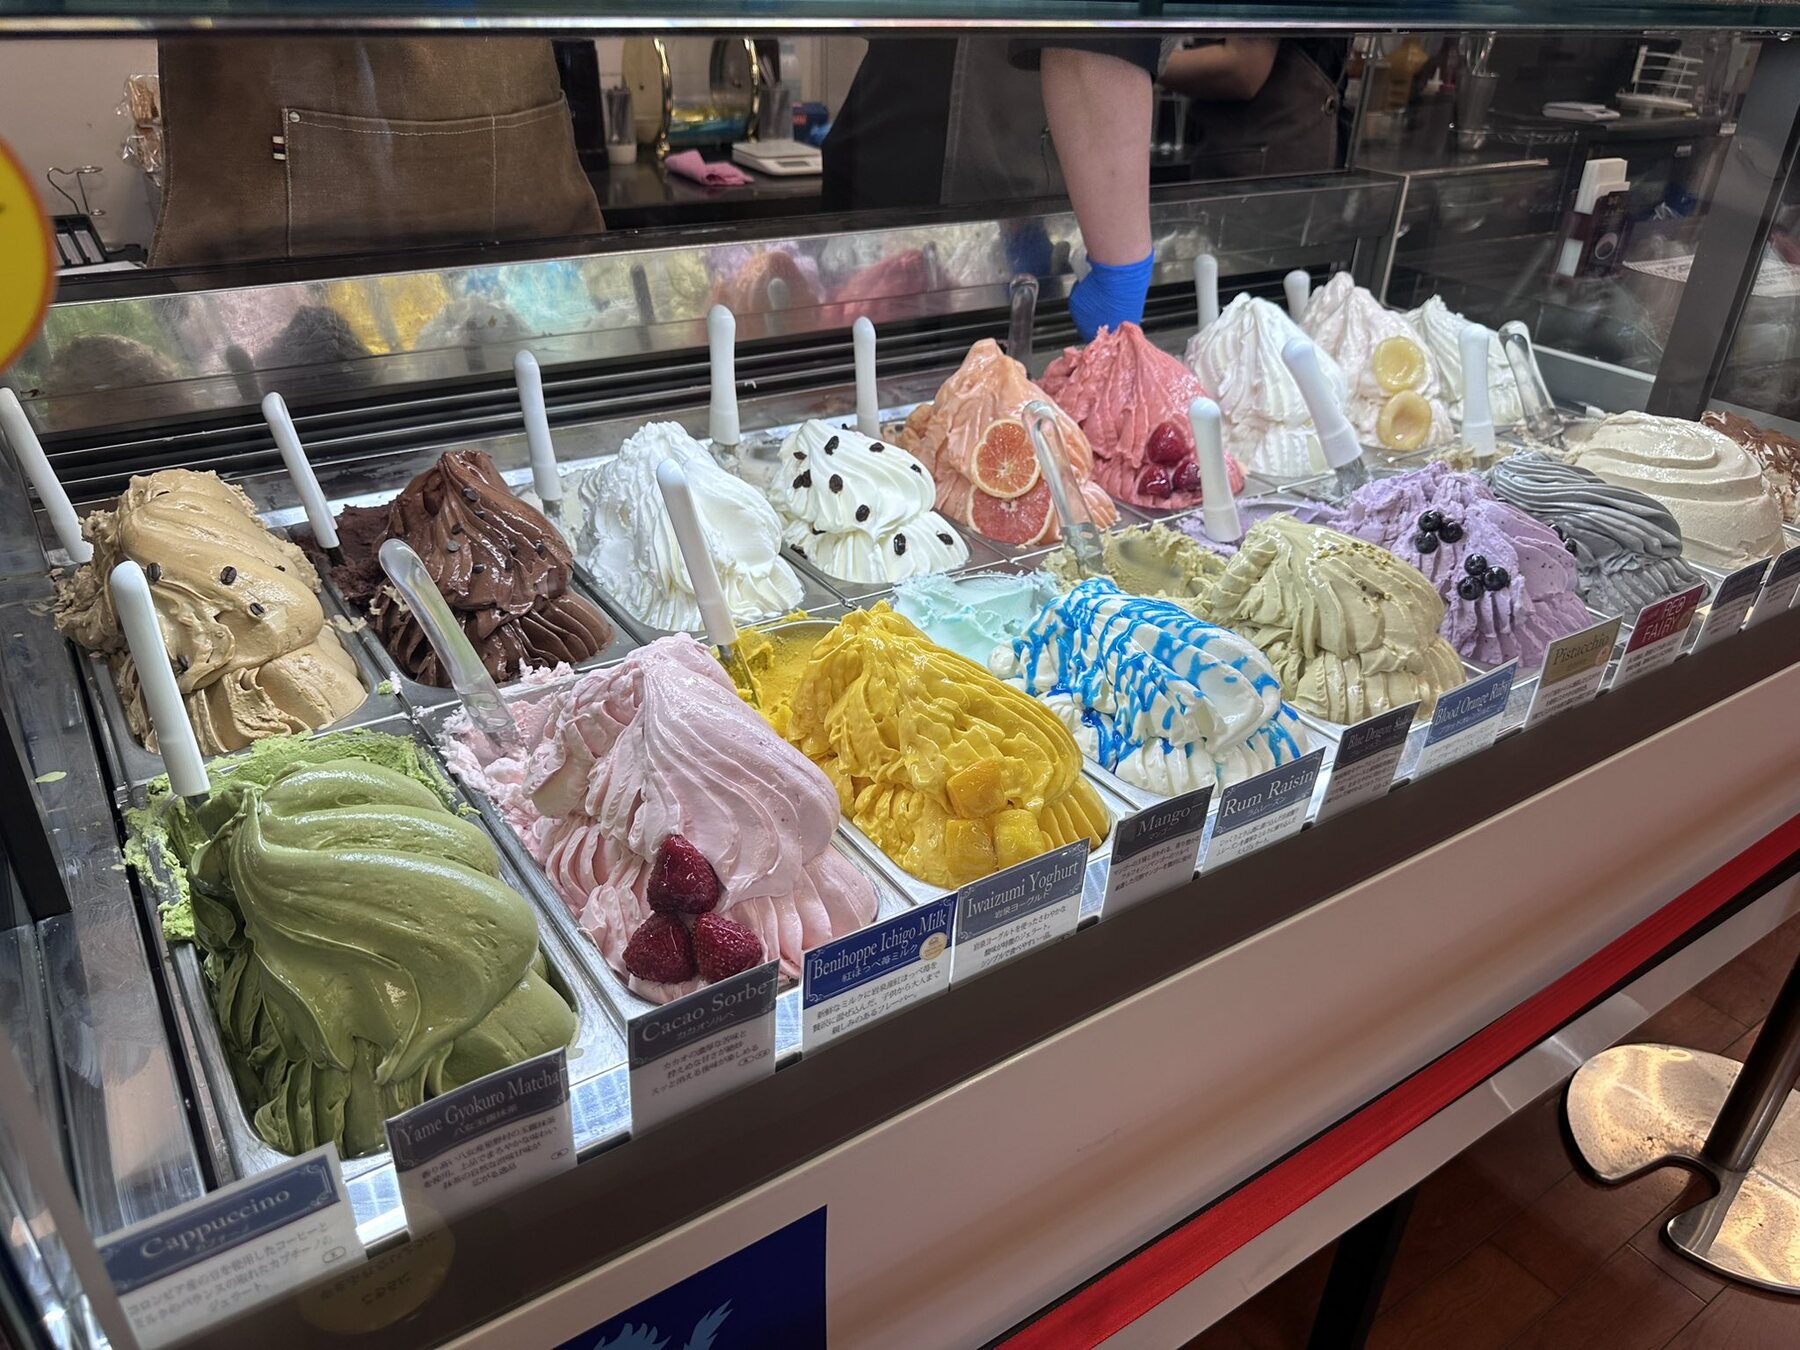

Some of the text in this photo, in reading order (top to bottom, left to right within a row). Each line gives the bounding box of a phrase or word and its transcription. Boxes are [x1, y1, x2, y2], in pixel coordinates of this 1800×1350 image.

[1661, 596, 1686, 618] RED
[1642, 616, 1679, 642] FAIRY
[1435, 701, 1460, 725] Blood
[1460, 692, 1488, 714] Orange
[1223, 792, 1262, 818] Rum
[1267, 770, 1315, 799] Raisin
[1136, 806, 1191, 837] Mango
[966, 861, 1079, 918] Iwaizumi Yoghurt
[993, 891, 1050, 919] 岩泉ヨーグルト
[813, 942, 878, 979] Benihoppe
[880, 926, 916, 949] Ichigo
[918, 909, 947, 935] Milk
[842, 942, 918, 982] 紅ほっぺ苺ミルク
[642, 982, 768, 1042] Cacao Sorbe
[677, 1011, 735, 1040] カカオソルベ
[400, 1069, 560, 1146] Yame Gyokuro Matcha
[140, 1188, 290, 1258] Cappuccino
